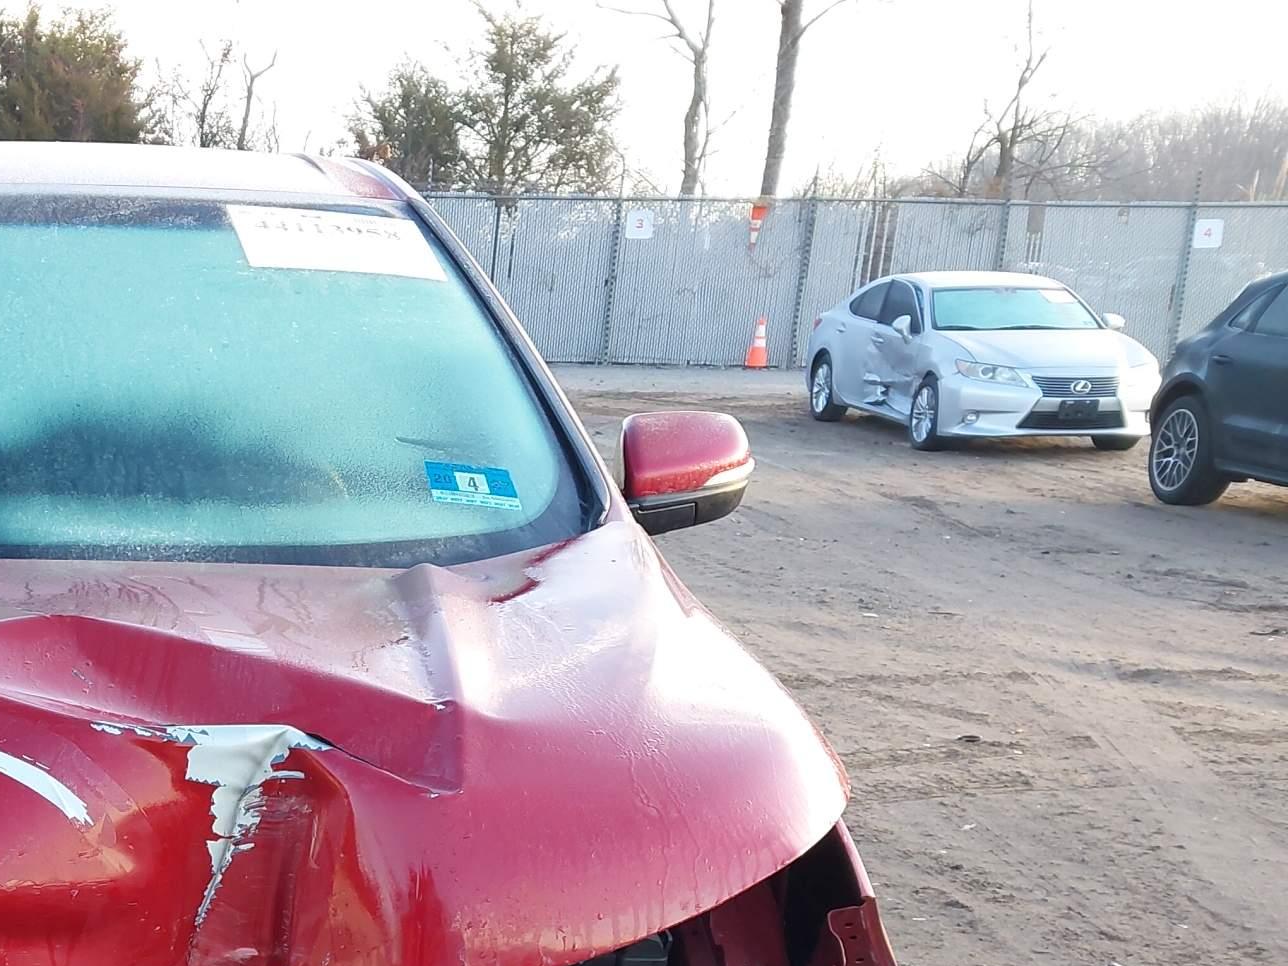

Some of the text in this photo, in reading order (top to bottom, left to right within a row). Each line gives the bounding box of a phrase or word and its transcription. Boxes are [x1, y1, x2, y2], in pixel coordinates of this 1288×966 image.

[635, 218, 644, 229] 3
[1203, 227, 1212, 238] 4
[467, 476, 479, 491] 4
